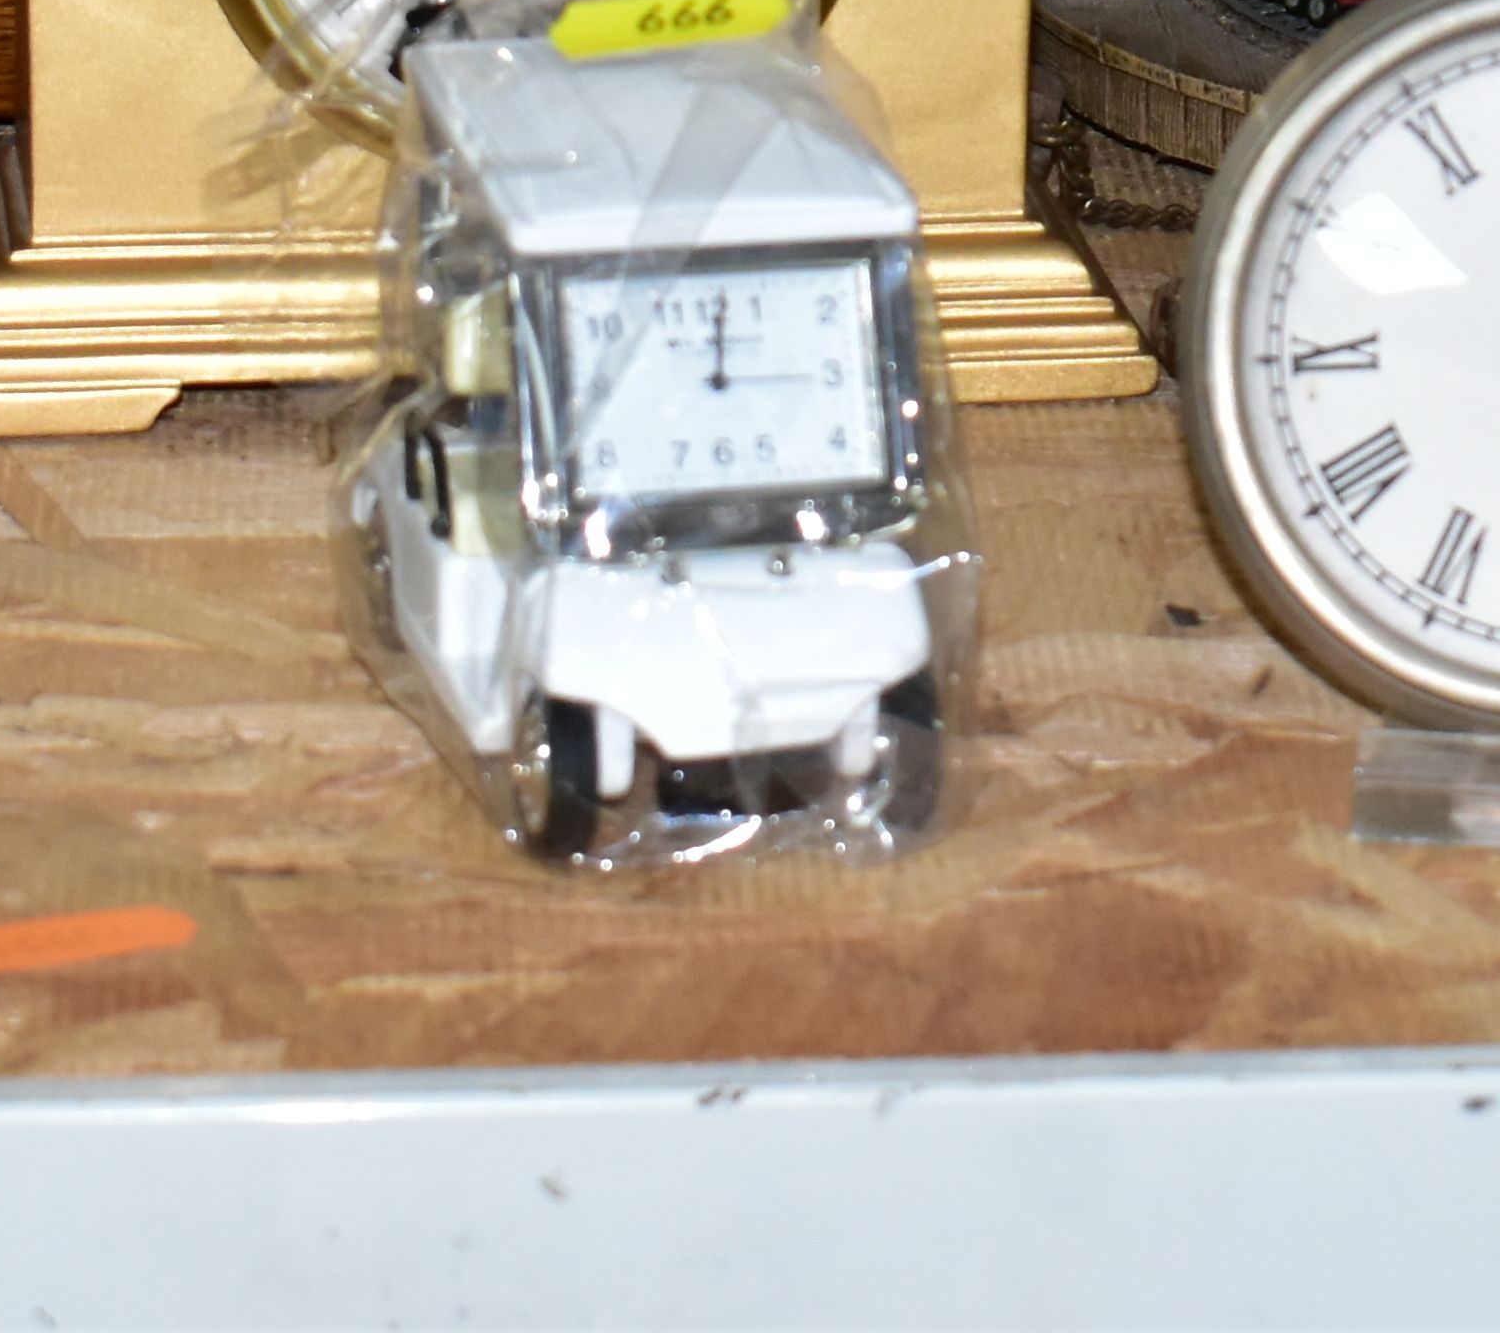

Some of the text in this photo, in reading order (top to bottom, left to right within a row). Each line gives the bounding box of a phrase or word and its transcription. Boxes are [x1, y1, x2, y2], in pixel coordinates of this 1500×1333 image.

[1402, 103, 1481, 197] XI
[653, 298, 684, 326] 11
[818, 294, 838, 324] 2
[587, 312, 624, 340] 10
[1292, 332, 1381, 376] IX
[823, 358, 845, 389] 3
[598, 438, 619, 468] 8
[673, 439, 691, 468] 7
[713, 436, 736, 466] 6
[756, 433, 777, 463] 5
[828, 425, 847, 452] 4
[1320, 424, 1412, 522] VIII
[1418, 507, 1490, 606] VII
